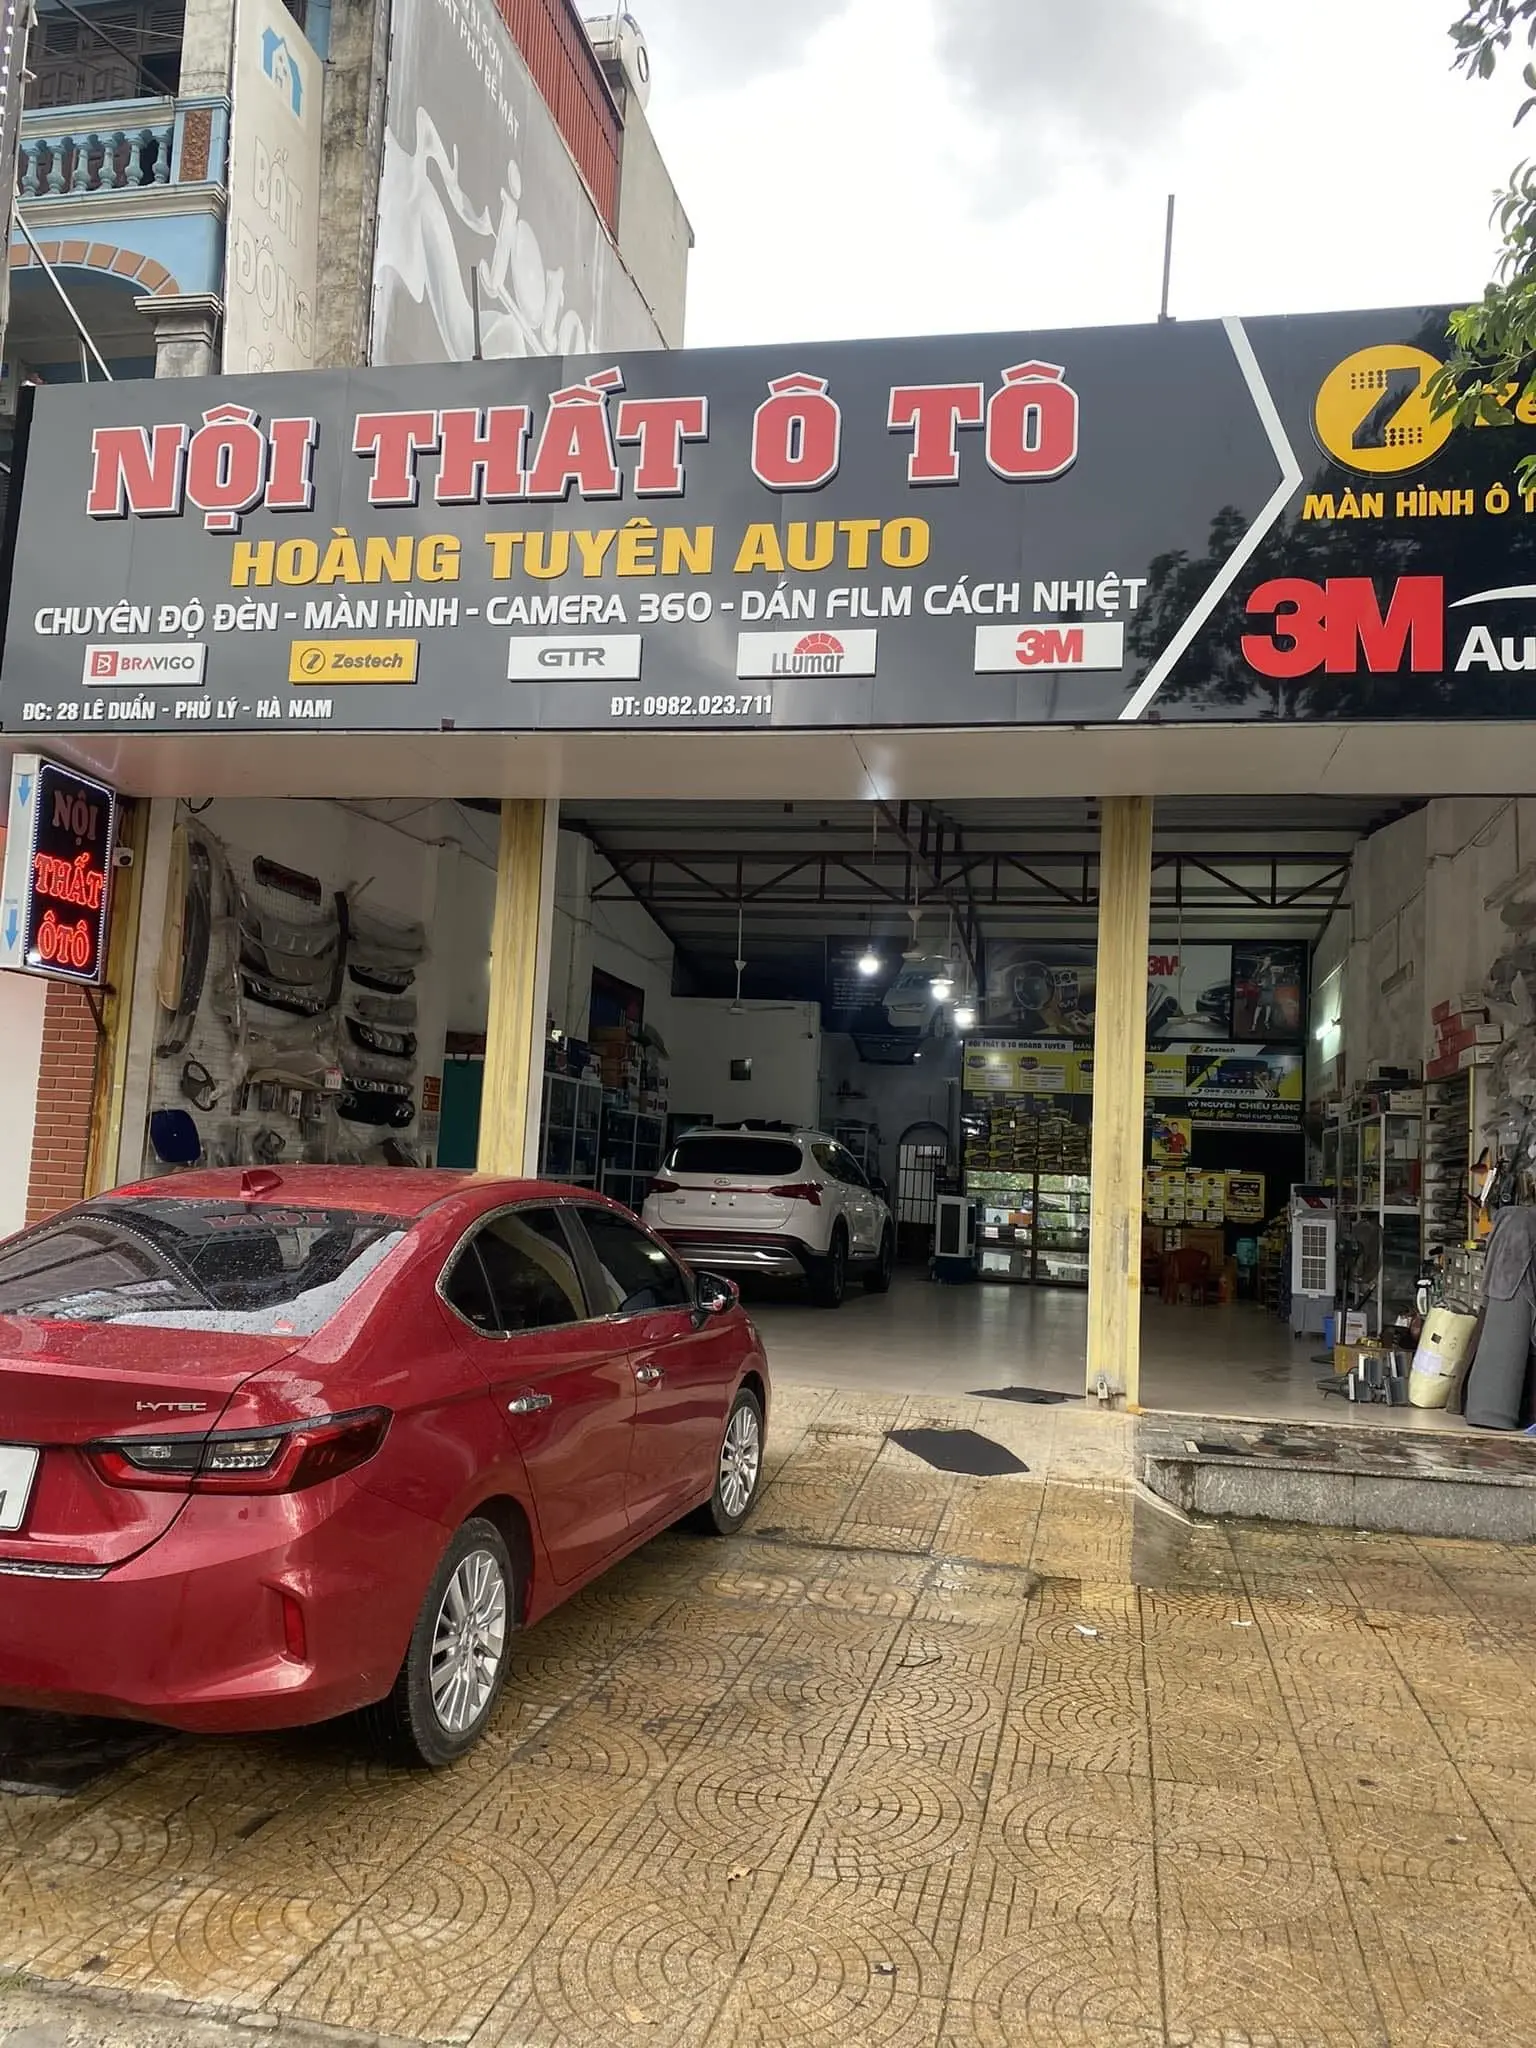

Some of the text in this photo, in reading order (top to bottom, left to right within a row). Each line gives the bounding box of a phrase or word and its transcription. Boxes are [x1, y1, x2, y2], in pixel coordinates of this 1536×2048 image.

[234, 217, 313, 360] ĐỘNG
[86, 359, 1080, 533] NỘI THẤT Ô TÔ
[1302, 487, 1383, 520] MÀN
[1396, 484, 1474, 517] HÌNH
[1485, 482, 1509, 514] Ô
[230, 516, 931, 586] HOÀNG TUYÊN AUTO
[34, 599, 151, 635] CHUYÊN
[157, 597, 202, 639] ĐỘ
[213, 596, 279, 632] ĐÈN
[304, 593, 378, 630] MÀN
[384, 591, 459, 628] HÌNH
[486, 591, 627, 625] CAMERA
[638, 591, 712, 623] 360
[740, 581, 817, 620] DÁN
[826, 585, 911, 618] FILM
[924, 576, 1019, 616] CÁCH
[1032, 571, 1148, 618] NHIỆT
[1240, 576, 1443, 678] 3M
[119, 655, 195, 673] BRAVIGO
[331, 651, 403, 671] Zestech
[538, 647, 606, 667] GTR
[1015, 629, 1083, 664] 3M
[22, 703, 53, 721] ĐC:
[56, 702, 79, 720] 28
[83, 697, 104, 720] LÊ
[107, 694, 155, 720] DUẨN
[175, 695, 209, 719] PHỦ
[216, 696, 237, 719] LÝ
[256, 695, 281, 719] HÀ
[289, 699, 333, 718] NAM
[611, 694, 773, 716] ĐT: 0982.023.711
[52, 788, 98, 846] NỘI
[35, 852, 103, 909] THẤT
[1148, 955, 1179, 977] 3M
